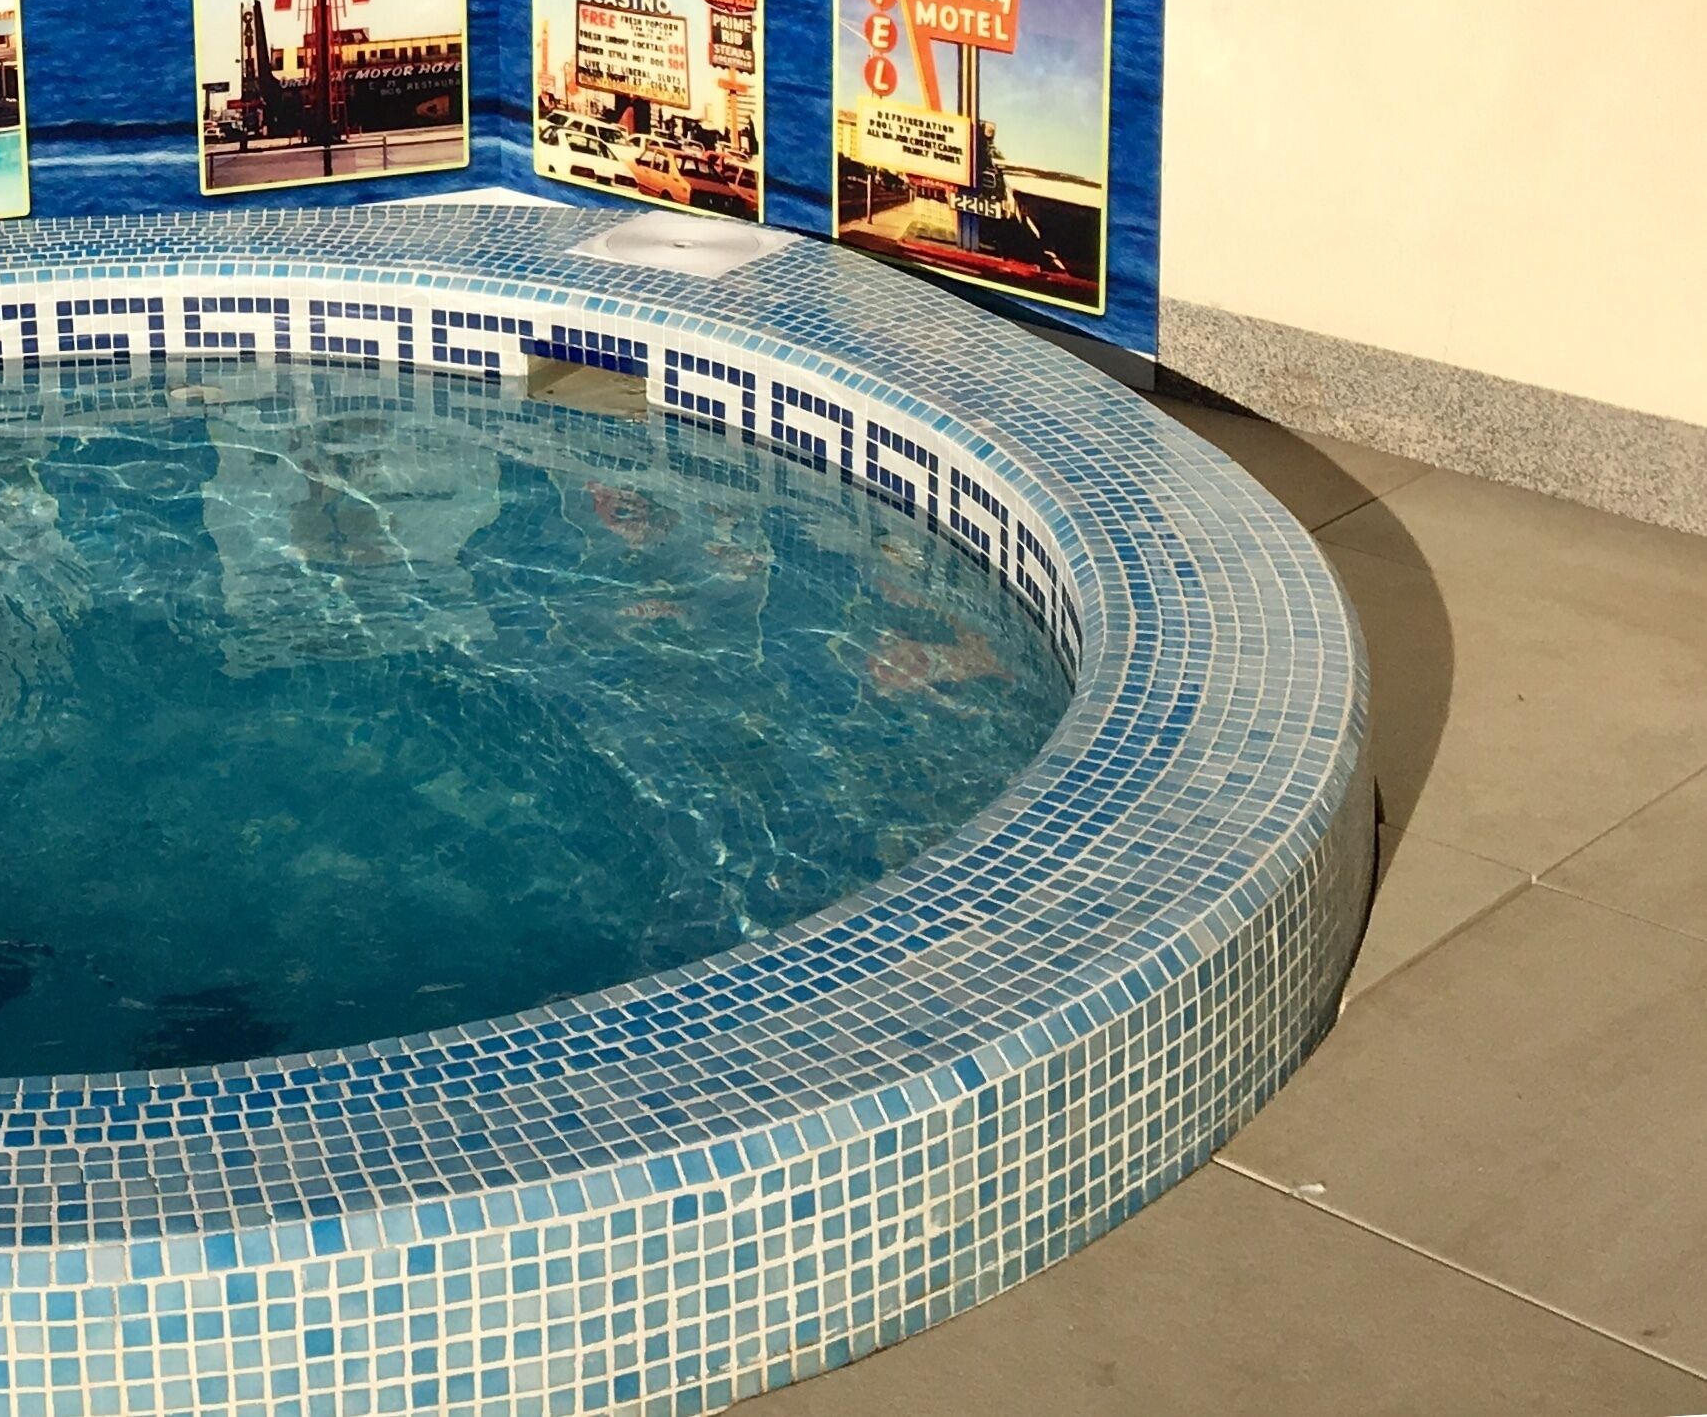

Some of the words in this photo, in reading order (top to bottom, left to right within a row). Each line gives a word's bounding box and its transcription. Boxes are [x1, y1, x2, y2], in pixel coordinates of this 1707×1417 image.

[581, 9, 617, 29] FREE
[713, 13, 751, 33] PRIME
[915, 1, 1009, 41] MOTEL
[721, 30, 743, 45] RIB
[714, 44, 752, 60] STEAKS
[355, 65, 414, 79] MOTOR
